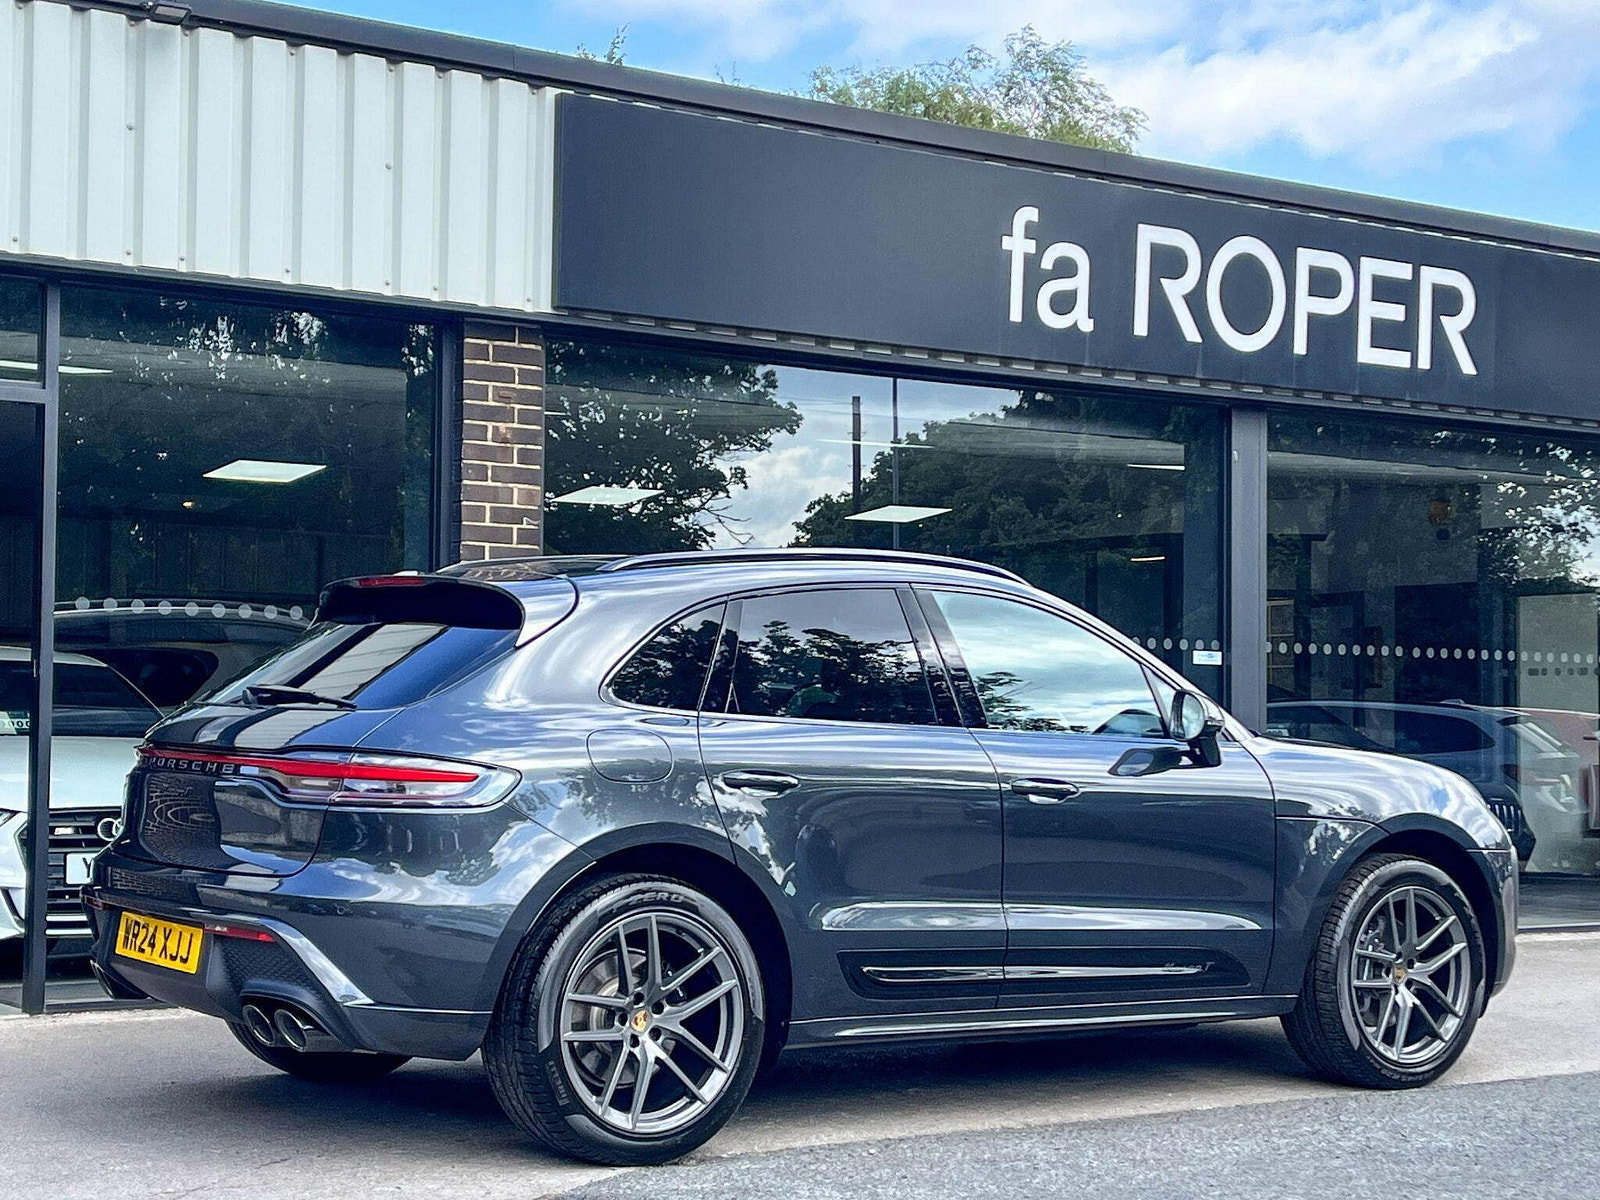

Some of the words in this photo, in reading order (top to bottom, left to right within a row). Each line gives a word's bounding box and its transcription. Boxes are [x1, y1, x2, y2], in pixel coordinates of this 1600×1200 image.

[1001, 206, 1095, 333] fa
[1133, 223, 1478, 376] ROPER
[149, 757, 235, 774] PORSCHE
[122, 918, 158, 957] WR24
[159, 926, 194, 964] XJJ
